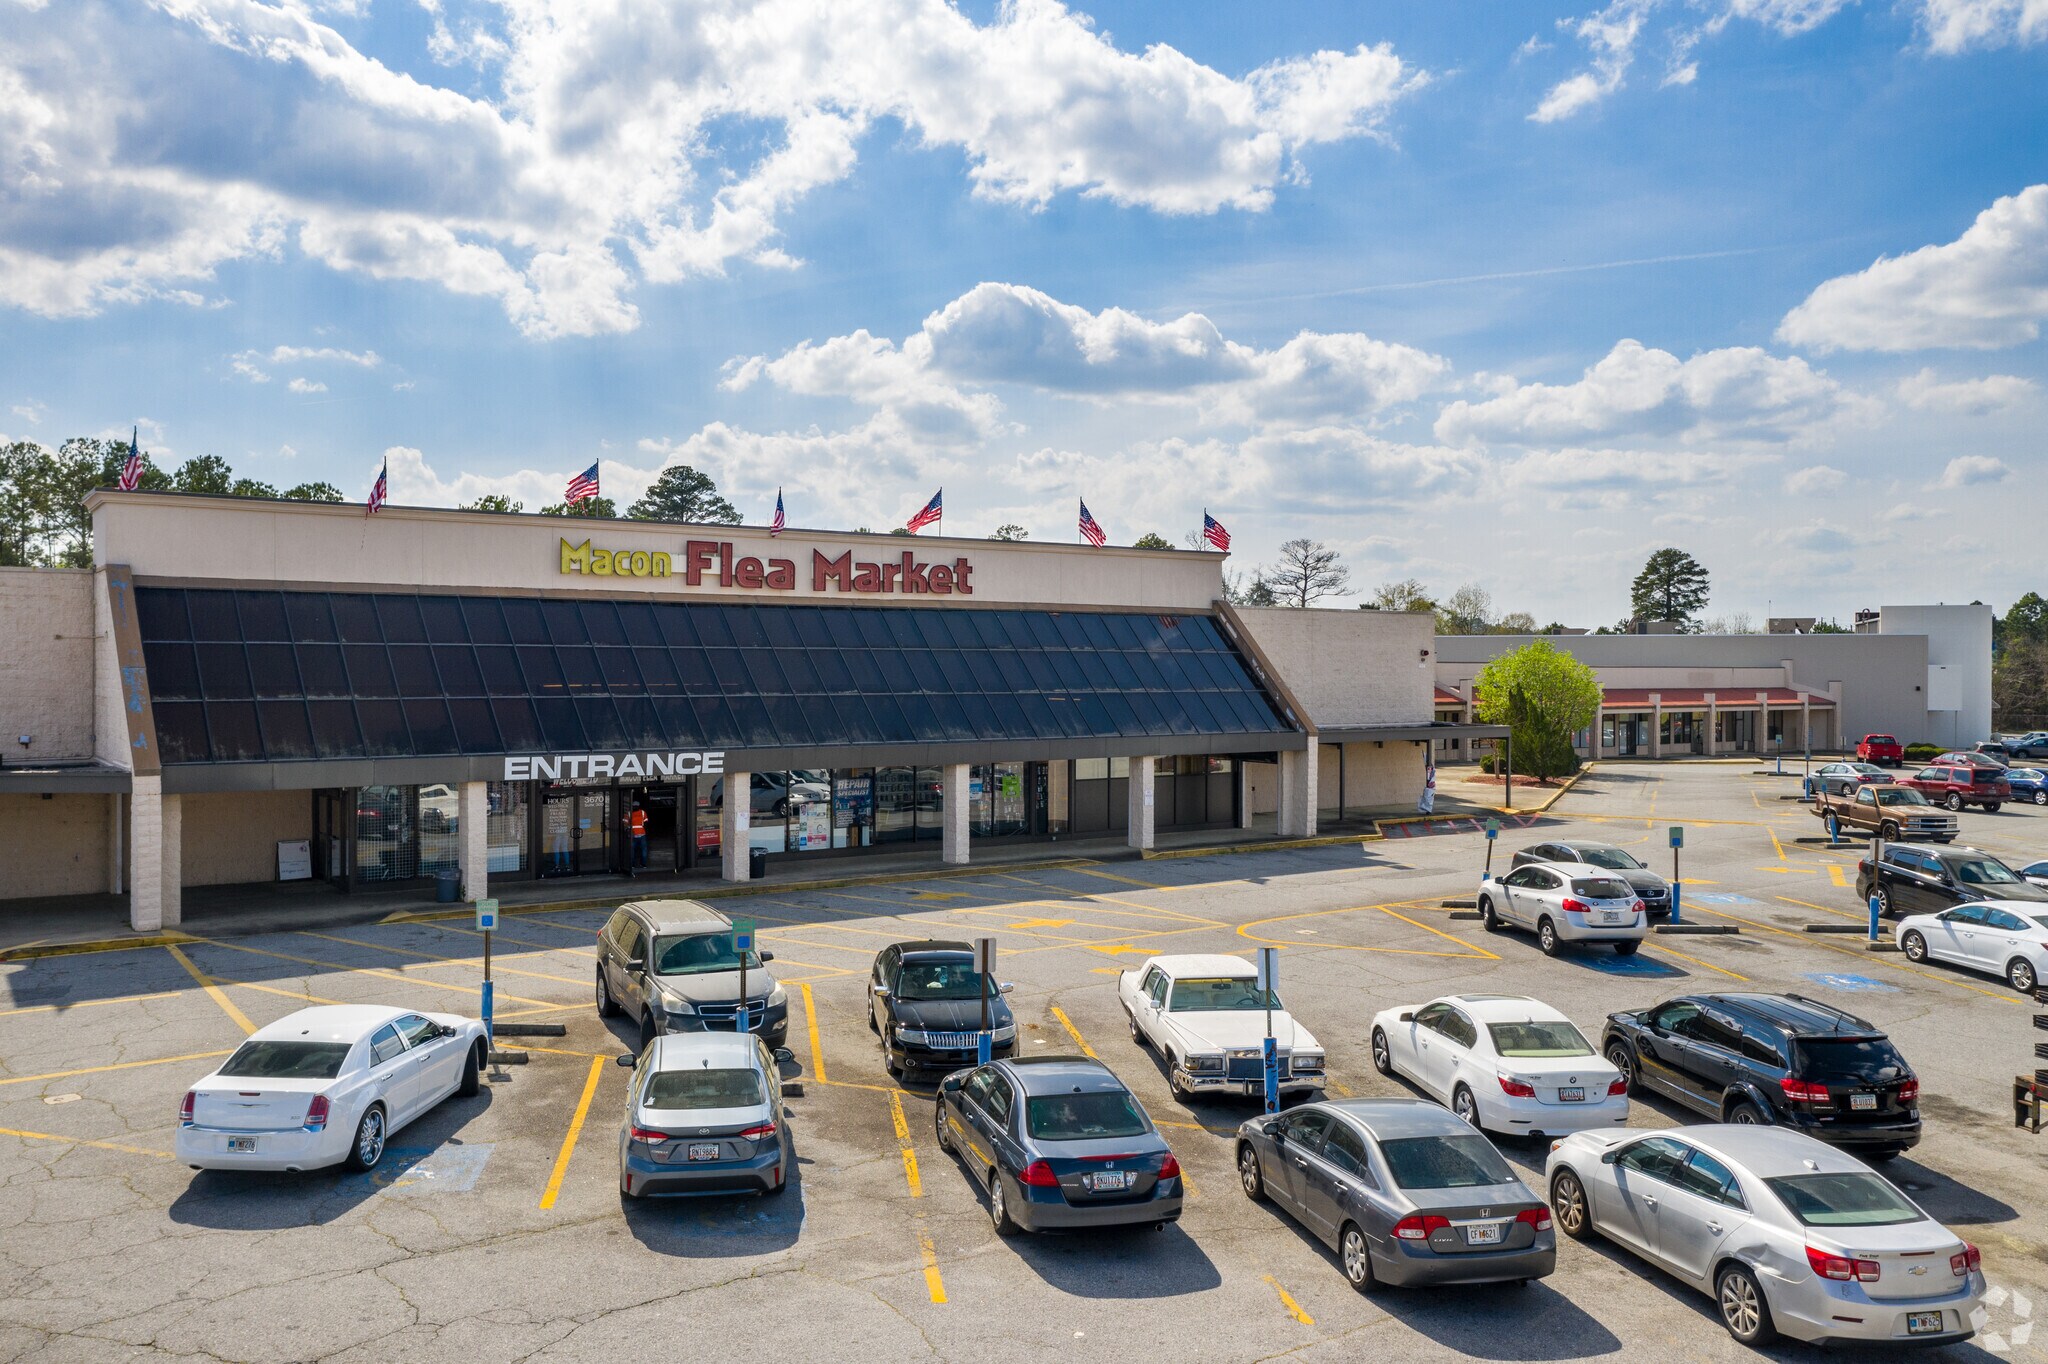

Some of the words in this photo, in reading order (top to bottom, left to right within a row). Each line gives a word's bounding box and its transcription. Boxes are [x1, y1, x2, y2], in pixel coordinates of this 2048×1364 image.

[560, 537, 672, 577] Macon
[686, 540, 796, 590] Flea
[812, 548, 973, 594] Market
[504, 752, 725, 780] ENTRANCE
[837, 779, 870, 789] REPAIR
